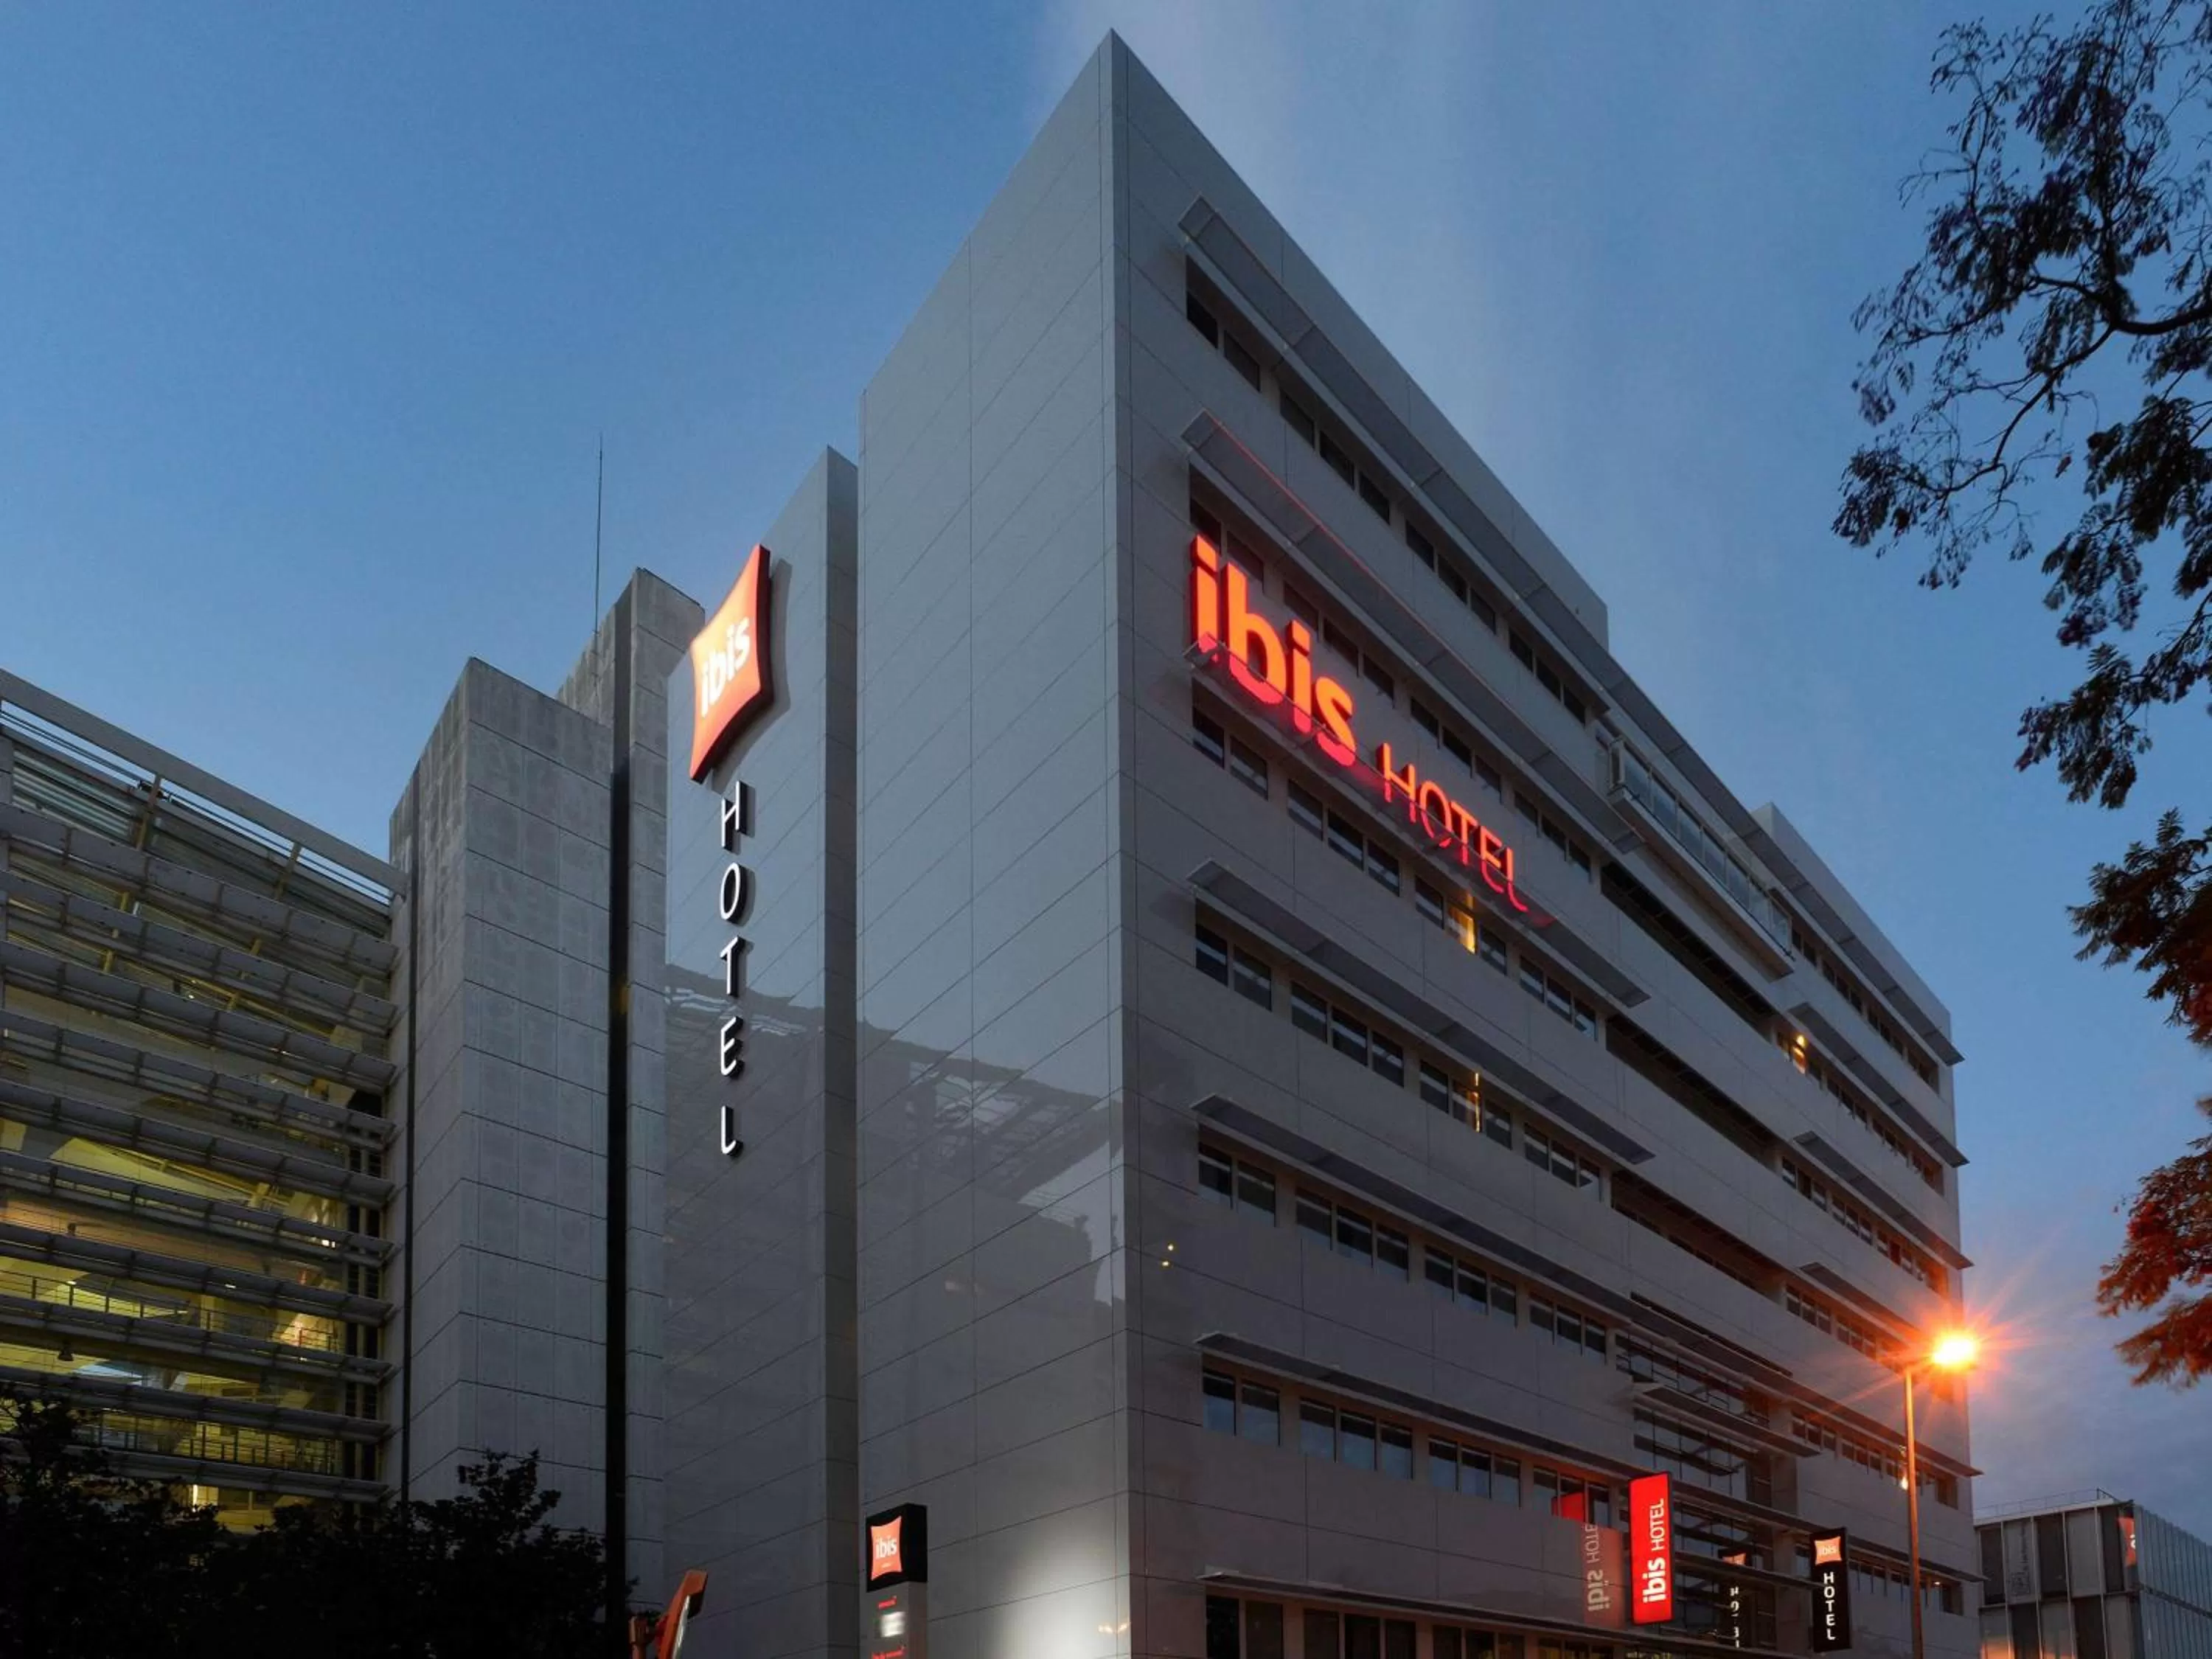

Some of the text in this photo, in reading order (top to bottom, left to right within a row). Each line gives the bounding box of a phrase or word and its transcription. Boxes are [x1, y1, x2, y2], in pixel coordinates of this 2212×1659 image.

[701, 616, 751, 718] ibis
[1191, 535, 1528, 912] ibis HOTEL
[720, 780, 743, 1155] HOTEL
[875, 1535, 897, 1559] ibis
[1642, 1498, 1666, 1604] ibis HOTEL
[1823, 1571, 1836, 1641] HOTEL
